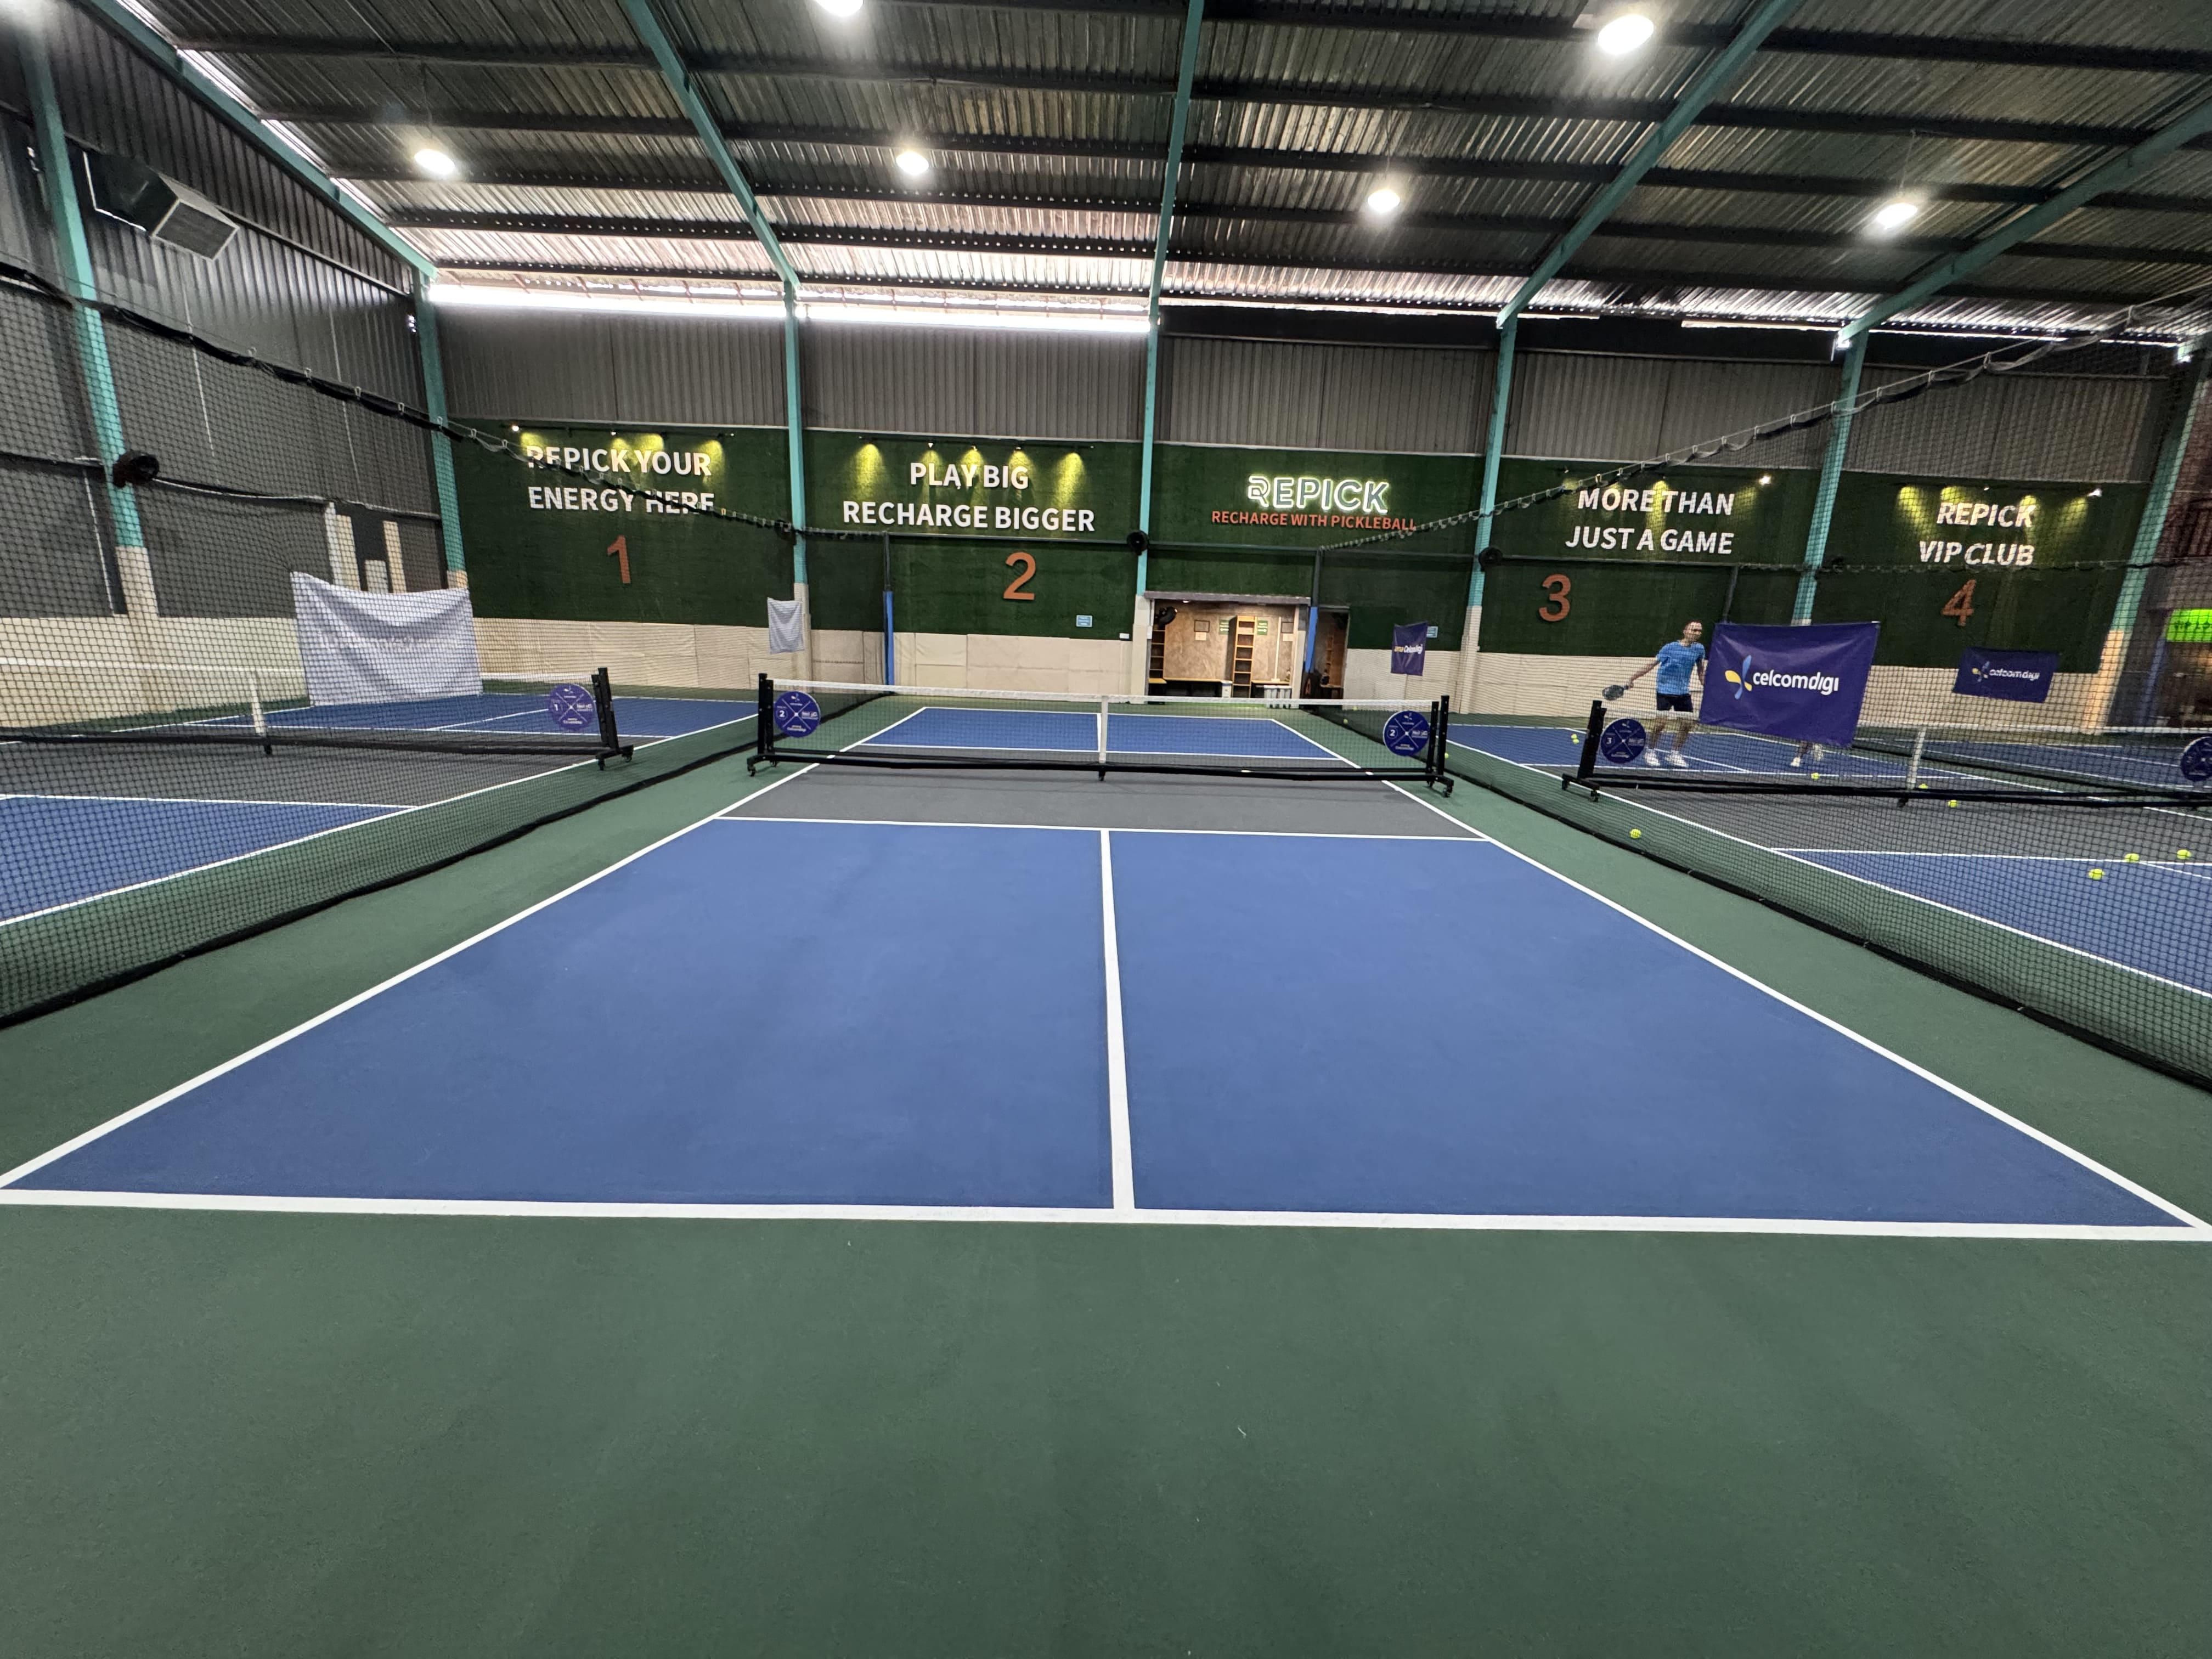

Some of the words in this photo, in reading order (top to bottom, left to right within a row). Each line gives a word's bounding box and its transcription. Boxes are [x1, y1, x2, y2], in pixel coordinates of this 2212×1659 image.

[635, 449, 712, 476] YOUR
[910, 462, 978, 488] PLAY
[983, 464, 1029, 490] BIG
[528, 486, 635, 512] ENERGY
[1247, 475, 1390, 514] REPICK
[1577, 488, 1655, 512] MORE
[1661, 490, 1736, 516] THAN
[843, 500, 989, 528] RECHARGE
[995, 506, 1096, 532] BIGGER
[1211, 510, 1288, 527] RECHARGE
[1290, 513, 1327, 527] WITH
[1331, 515, 1416, 532] PICKLEBALL
[1936, 501, 2036, 528] REPICK
[1565, 525, 1635, 550] JUST
[1637, 528, 1654, 551] A
[1660, 528, 1735, 554] GAME
[1919, 540, 1962, 563] VIP
[1964, 542, 2035, 567] CLUB
[606, 534, 632, 584] 1
[1003, 551, 1036, 601] 2
[1538, 573, 1572, 623] 3
[1941, 578, 1977, 627] 4
[1753, 669, 1839, 696] celcomdigi
